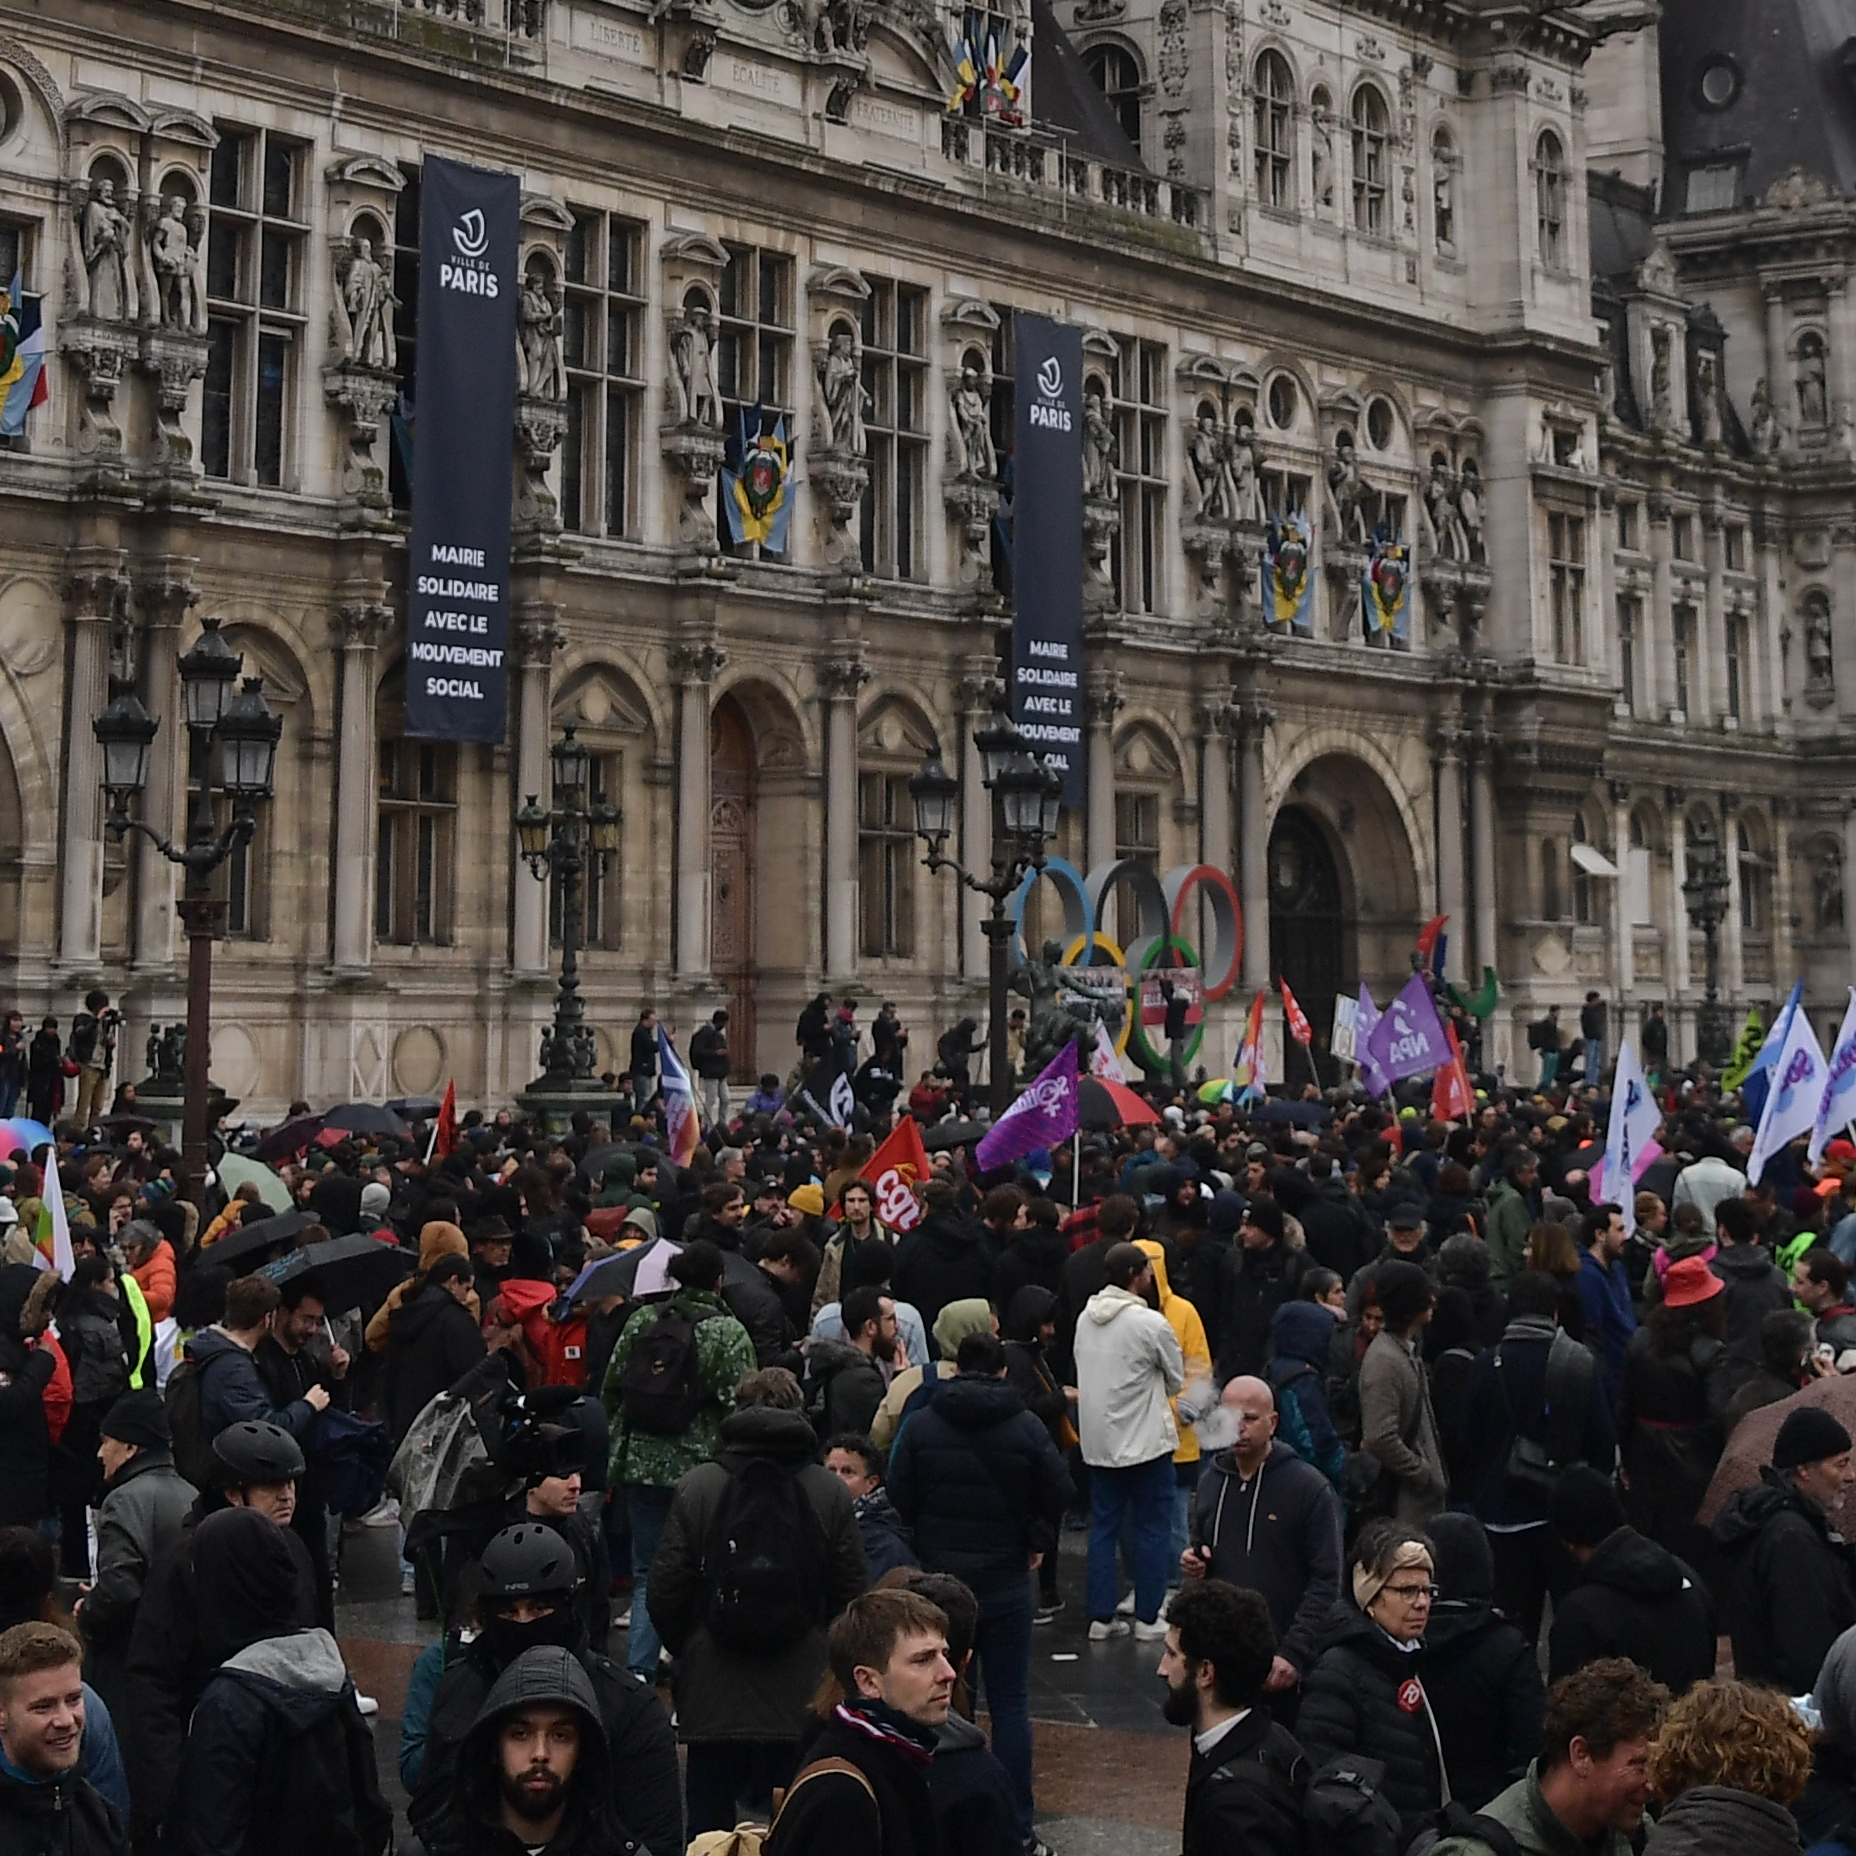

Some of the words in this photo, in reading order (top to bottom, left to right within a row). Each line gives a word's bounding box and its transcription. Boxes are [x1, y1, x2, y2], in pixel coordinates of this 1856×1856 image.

[451, 255, 475, 268] VILLE
[478, 260, 490, 272] DE
[440, 263, 499, 299] PARIS
[1030, 403, 1072, 432] PARIS
[431, 544, 486, 568] MAIRIE
[417, 575, 499, 602] SOLIDAIRE
[425, 610, 468, 632] AVEC
[469, 614, 489, 634] LE
[411, 641, 505, 668] MOUVEMENT
[1029, 639, 1069, 660] MAIRIE
[426, 676, 485, 700] SOCIAL
[1016, 666, 1079, 688] SOLIDAIRE
[1023, 695, 1058, 714] AVEC
[1058, 698, 1072, 716] LE
